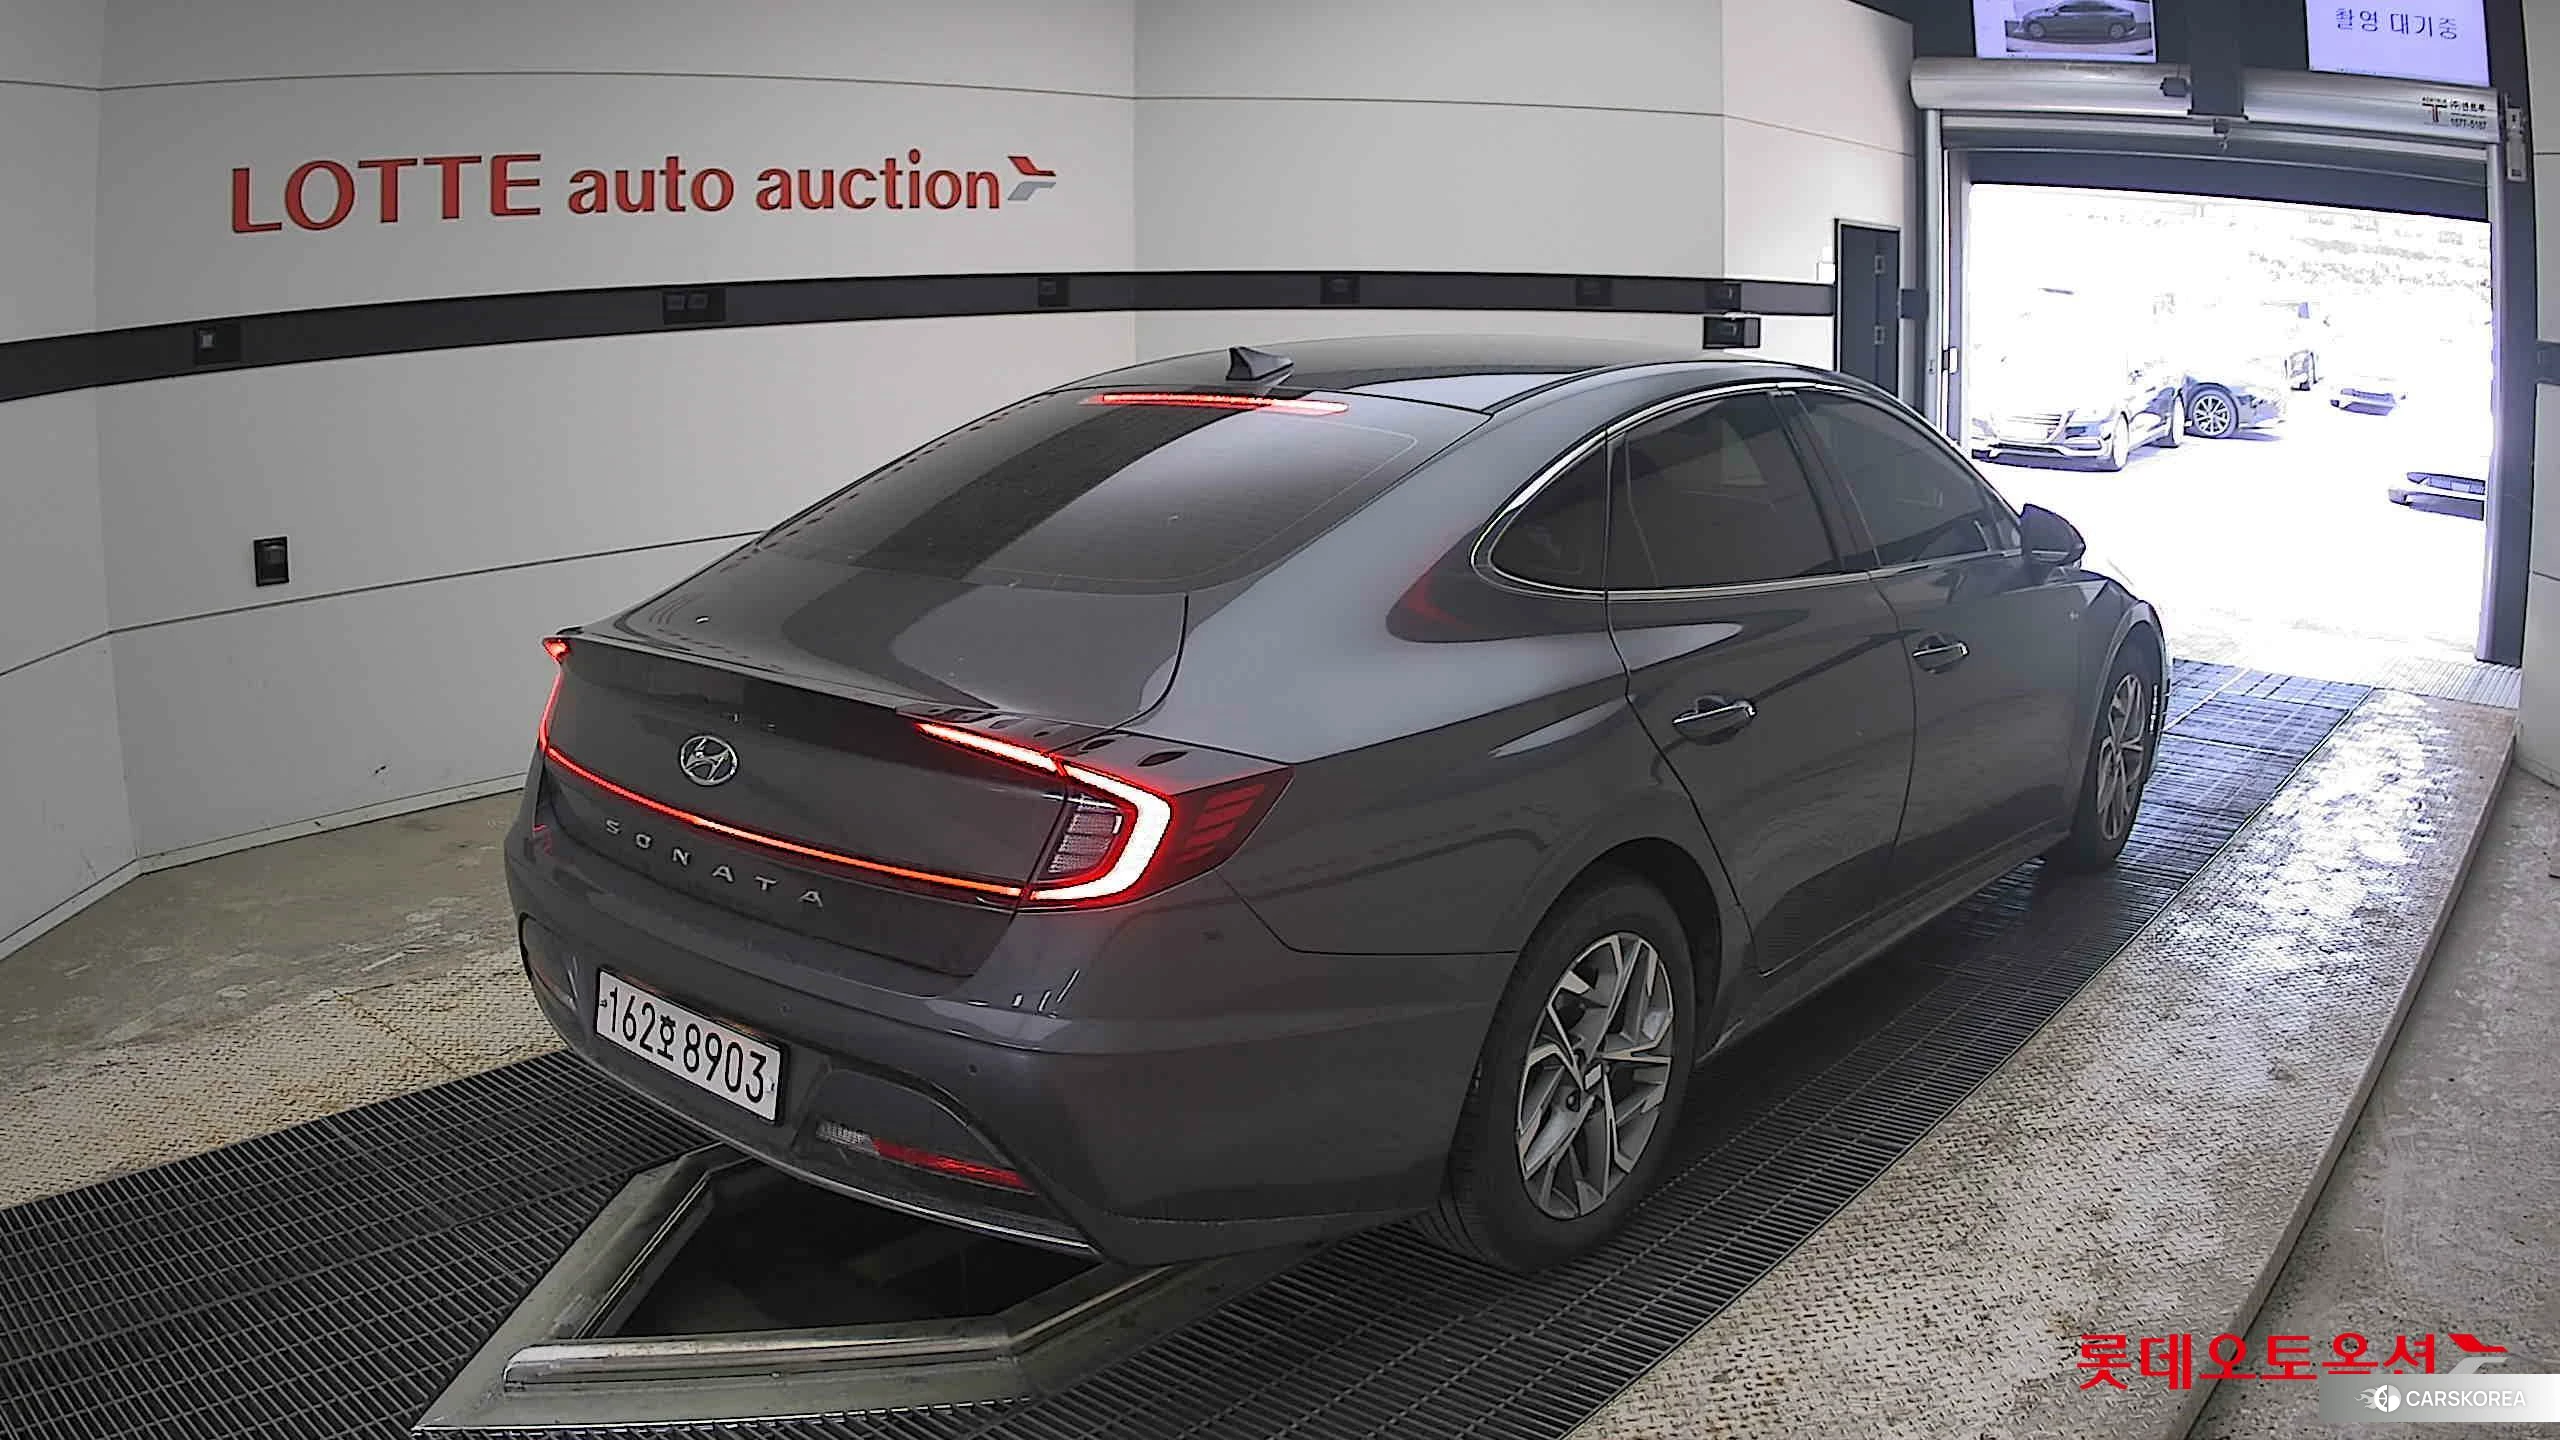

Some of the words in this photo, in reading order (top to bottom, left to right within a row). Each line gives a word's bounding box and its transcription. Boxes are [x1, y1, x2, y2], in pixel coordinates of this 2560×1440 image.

[2390, 12, 2458, 41] 대기중
[231, 153, 541, 234] LOTTE
[567, 154, 735, 215] auto
[756, 148, 1000, 212] auction
[604, 817, 825, 909] SONATA
